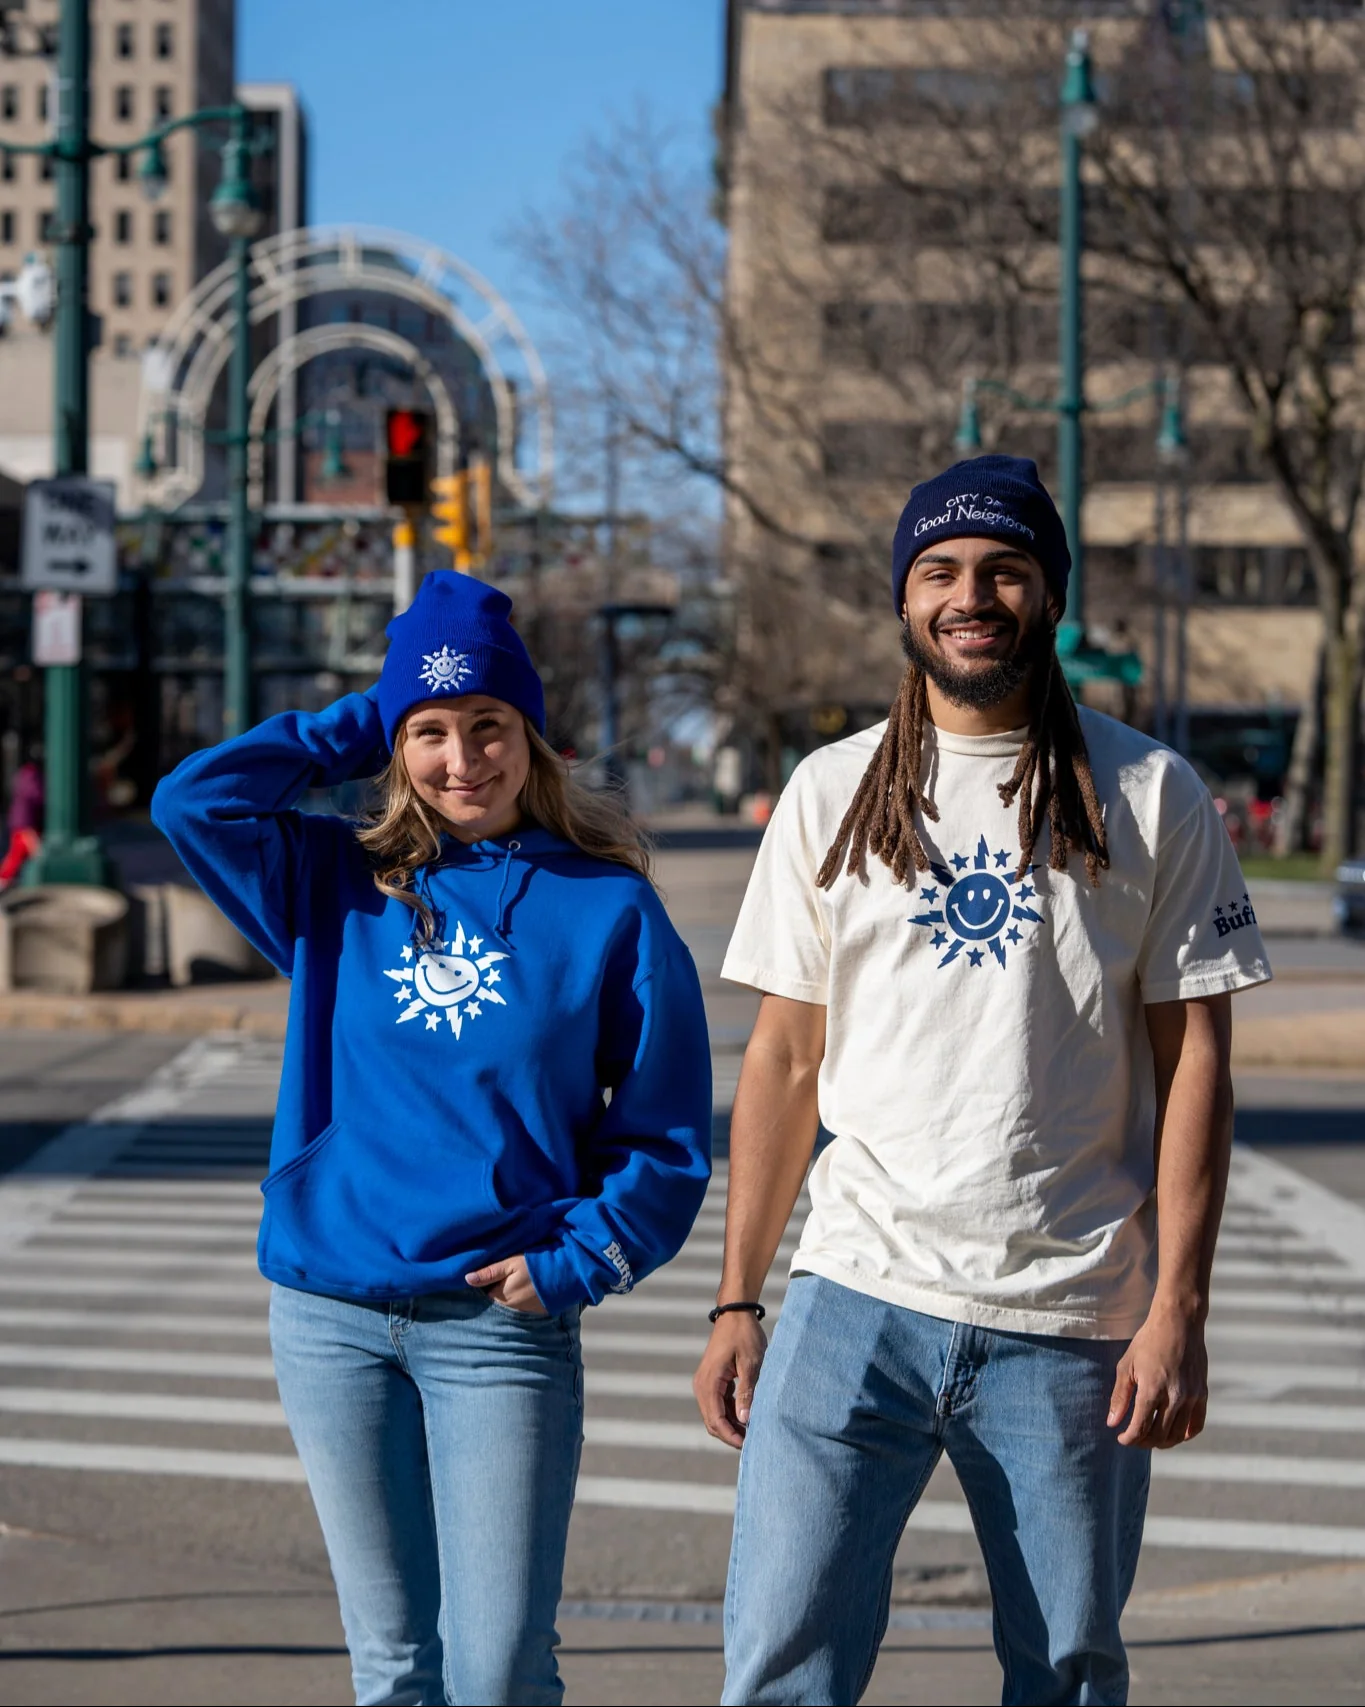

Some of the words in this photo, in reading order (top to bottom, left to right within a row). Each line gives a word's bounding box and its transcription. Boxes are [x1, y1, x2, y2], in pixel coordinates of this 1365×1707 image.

[946, 492, 980, 508] CITY
[983, 495, 1003, 507] OF
[914, 509, 952, 537] Good
[955, 504, 1036, 541] Neighbors
